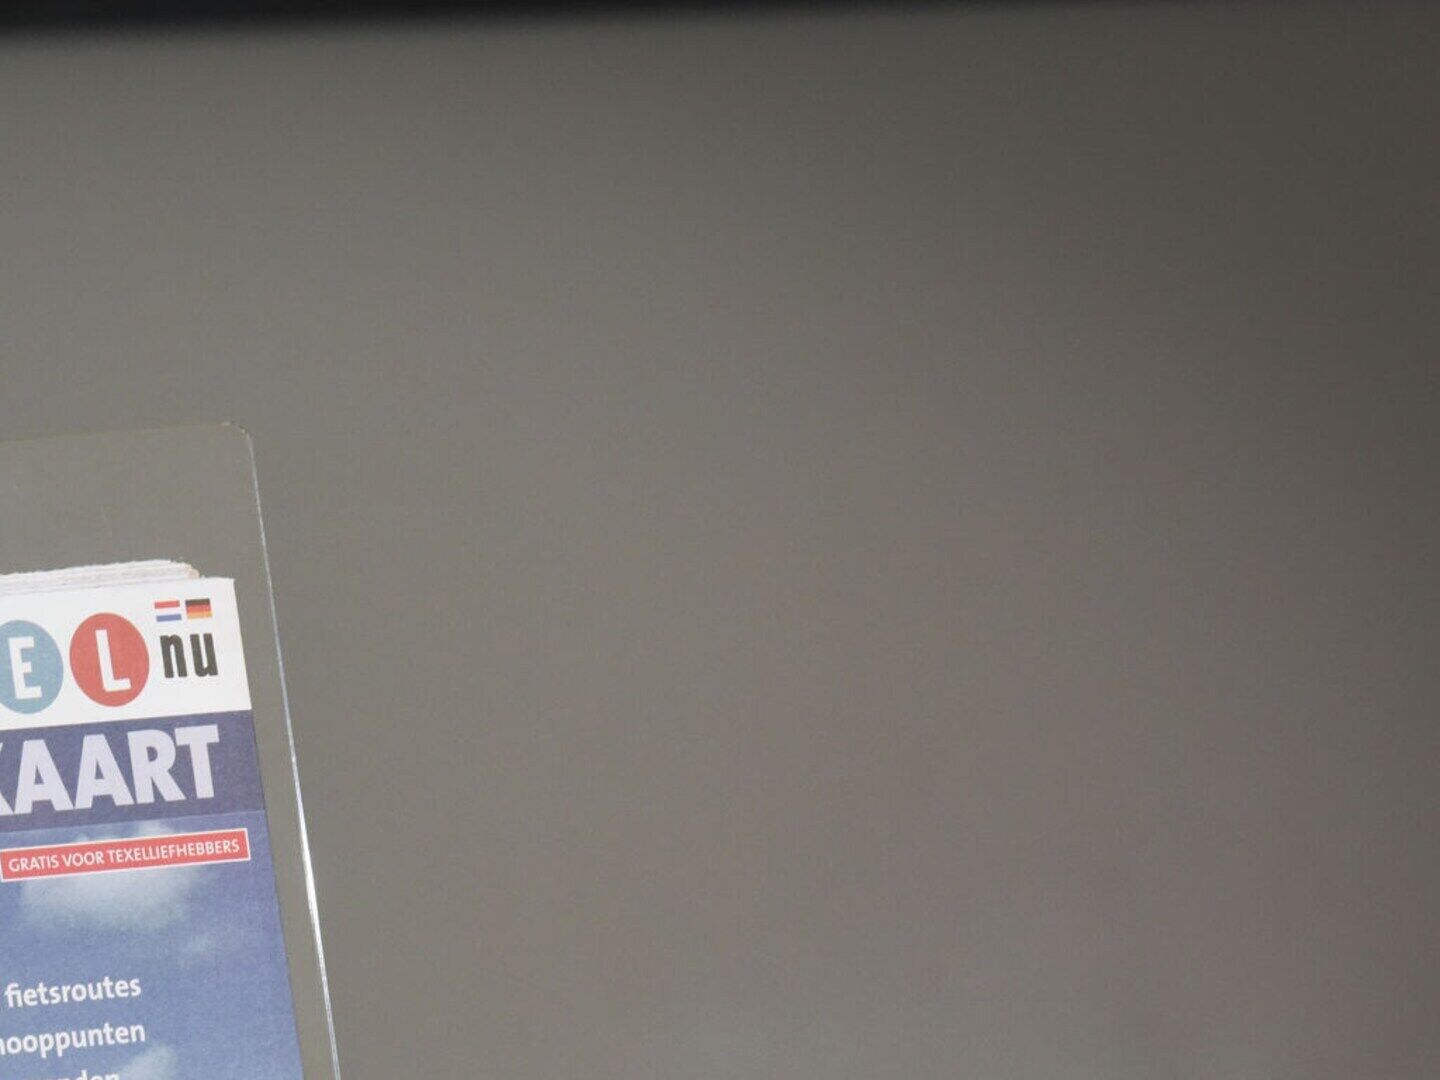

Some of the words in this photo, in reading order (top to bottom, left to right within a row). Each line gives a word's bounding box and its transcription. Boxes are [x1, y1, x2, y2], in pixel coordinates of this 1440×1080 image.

[160, 632, 218, 678] nu
[8, 853, 59, 873] GRATIS
[62, 848, 105, 868] VOOR
[108, 839, 241, 864] TEXELLIEFHEBBERS
[4, 975, 142, 1007] fietsroutes
